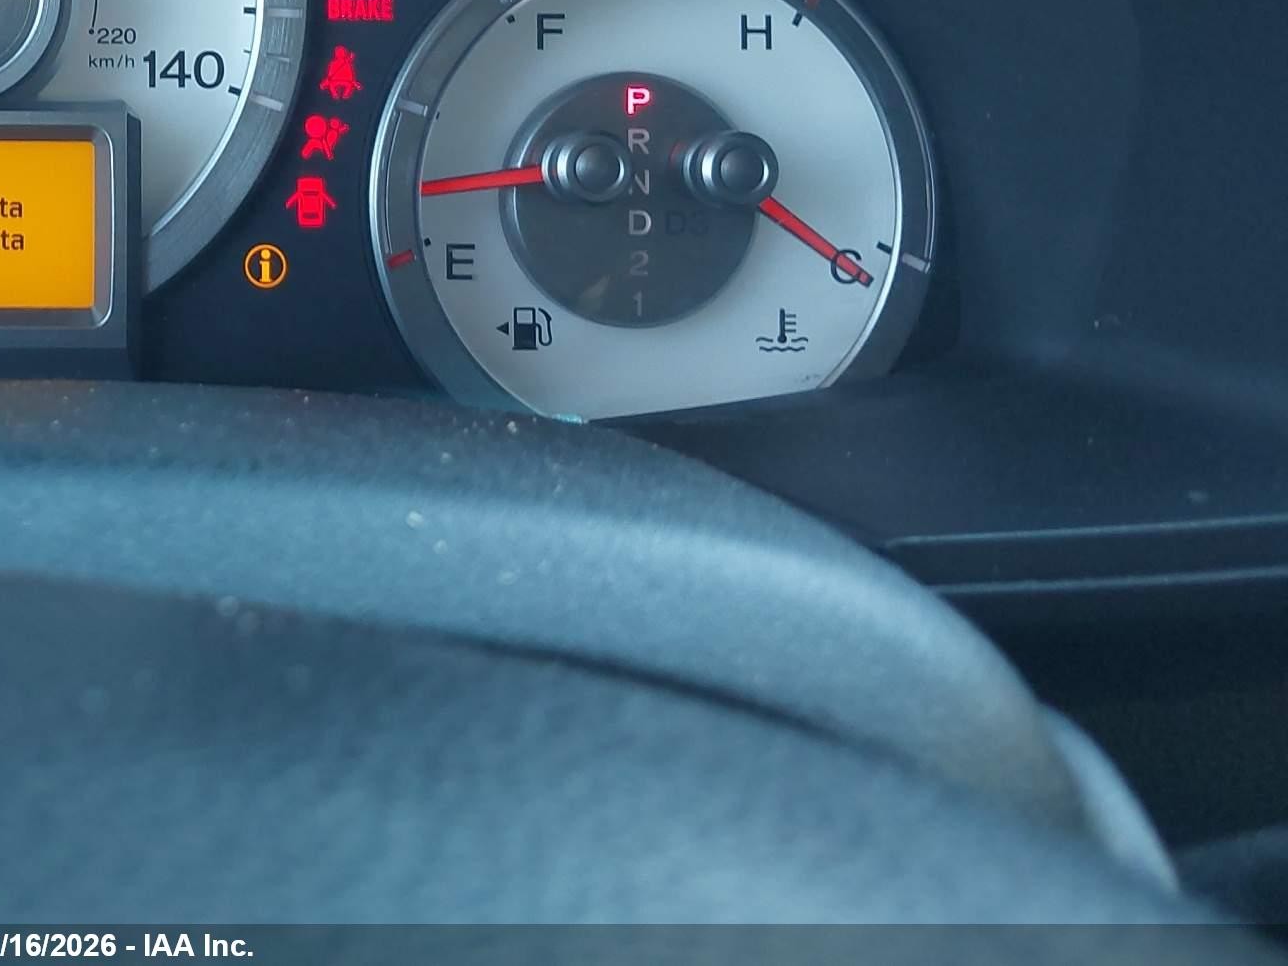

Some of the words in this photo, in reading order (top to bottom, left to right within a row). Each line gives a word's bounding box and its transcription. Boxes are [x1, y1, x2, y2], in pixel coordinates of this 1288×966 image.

[96, 27, 137, 45] 220
[536, 12, 566, 51] F
[740, 13, 773, 51] H
[88, 54, 135, 70] km/h
[142, 50, 226, 89] 140
[626, 87, 651, 115] P
[627, 128, 651, 156] R
[628, 169, 651, 196] N
[628, 209, 653, 236] D
[445, 242, 476, 281] E
[629, 249, 650, 276] 2
[829, 247, 863, 285] C
